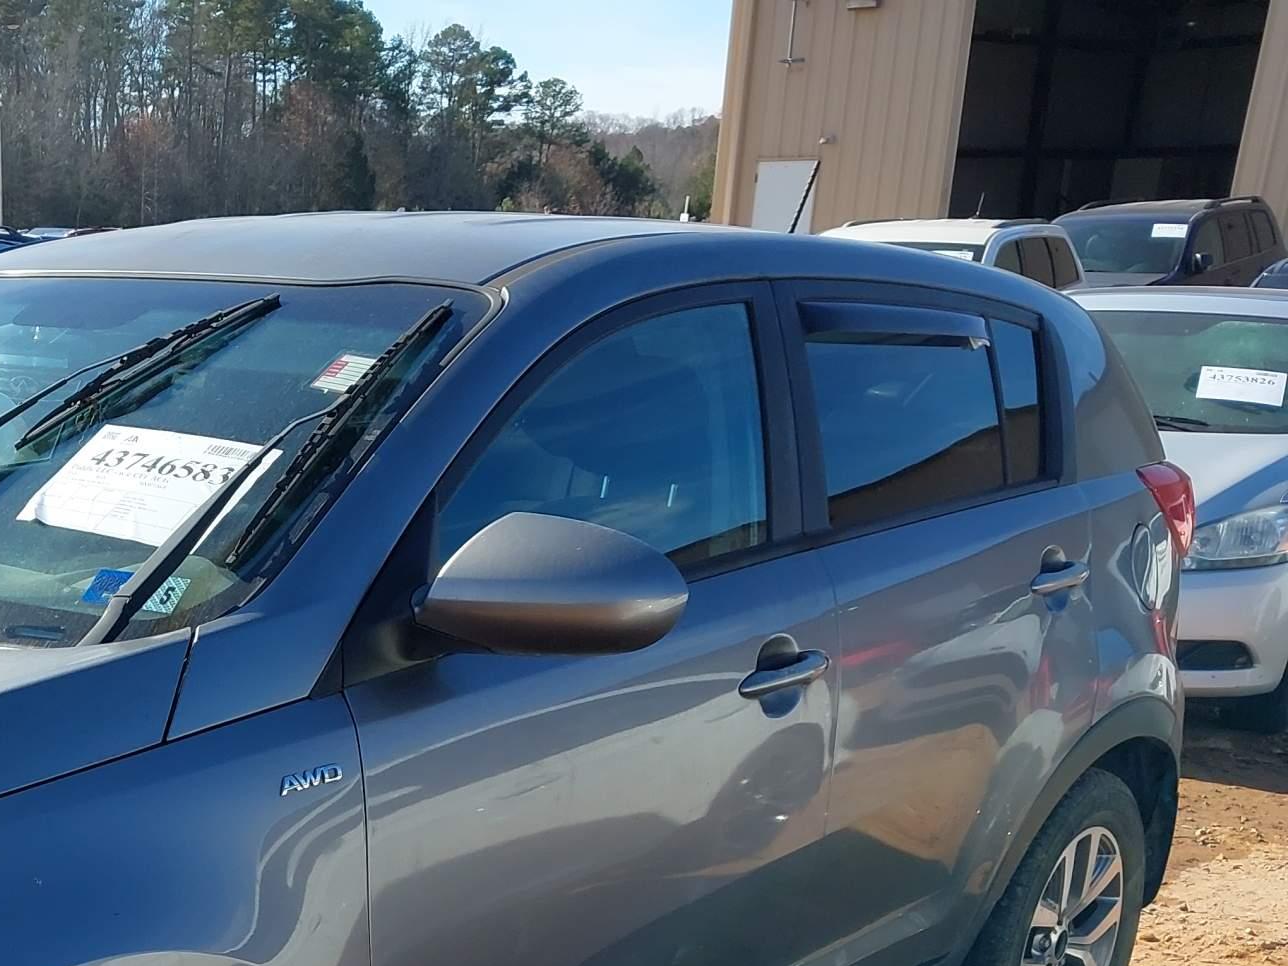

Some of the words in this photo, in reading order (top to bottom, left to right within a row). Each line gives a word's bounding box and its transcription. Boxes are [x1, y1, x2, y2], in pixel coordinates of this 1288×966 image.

[90, 448, 236, 486] 43746583
[159, 586, 177, 605] 5
[280, 763, 344, 796] AWD
